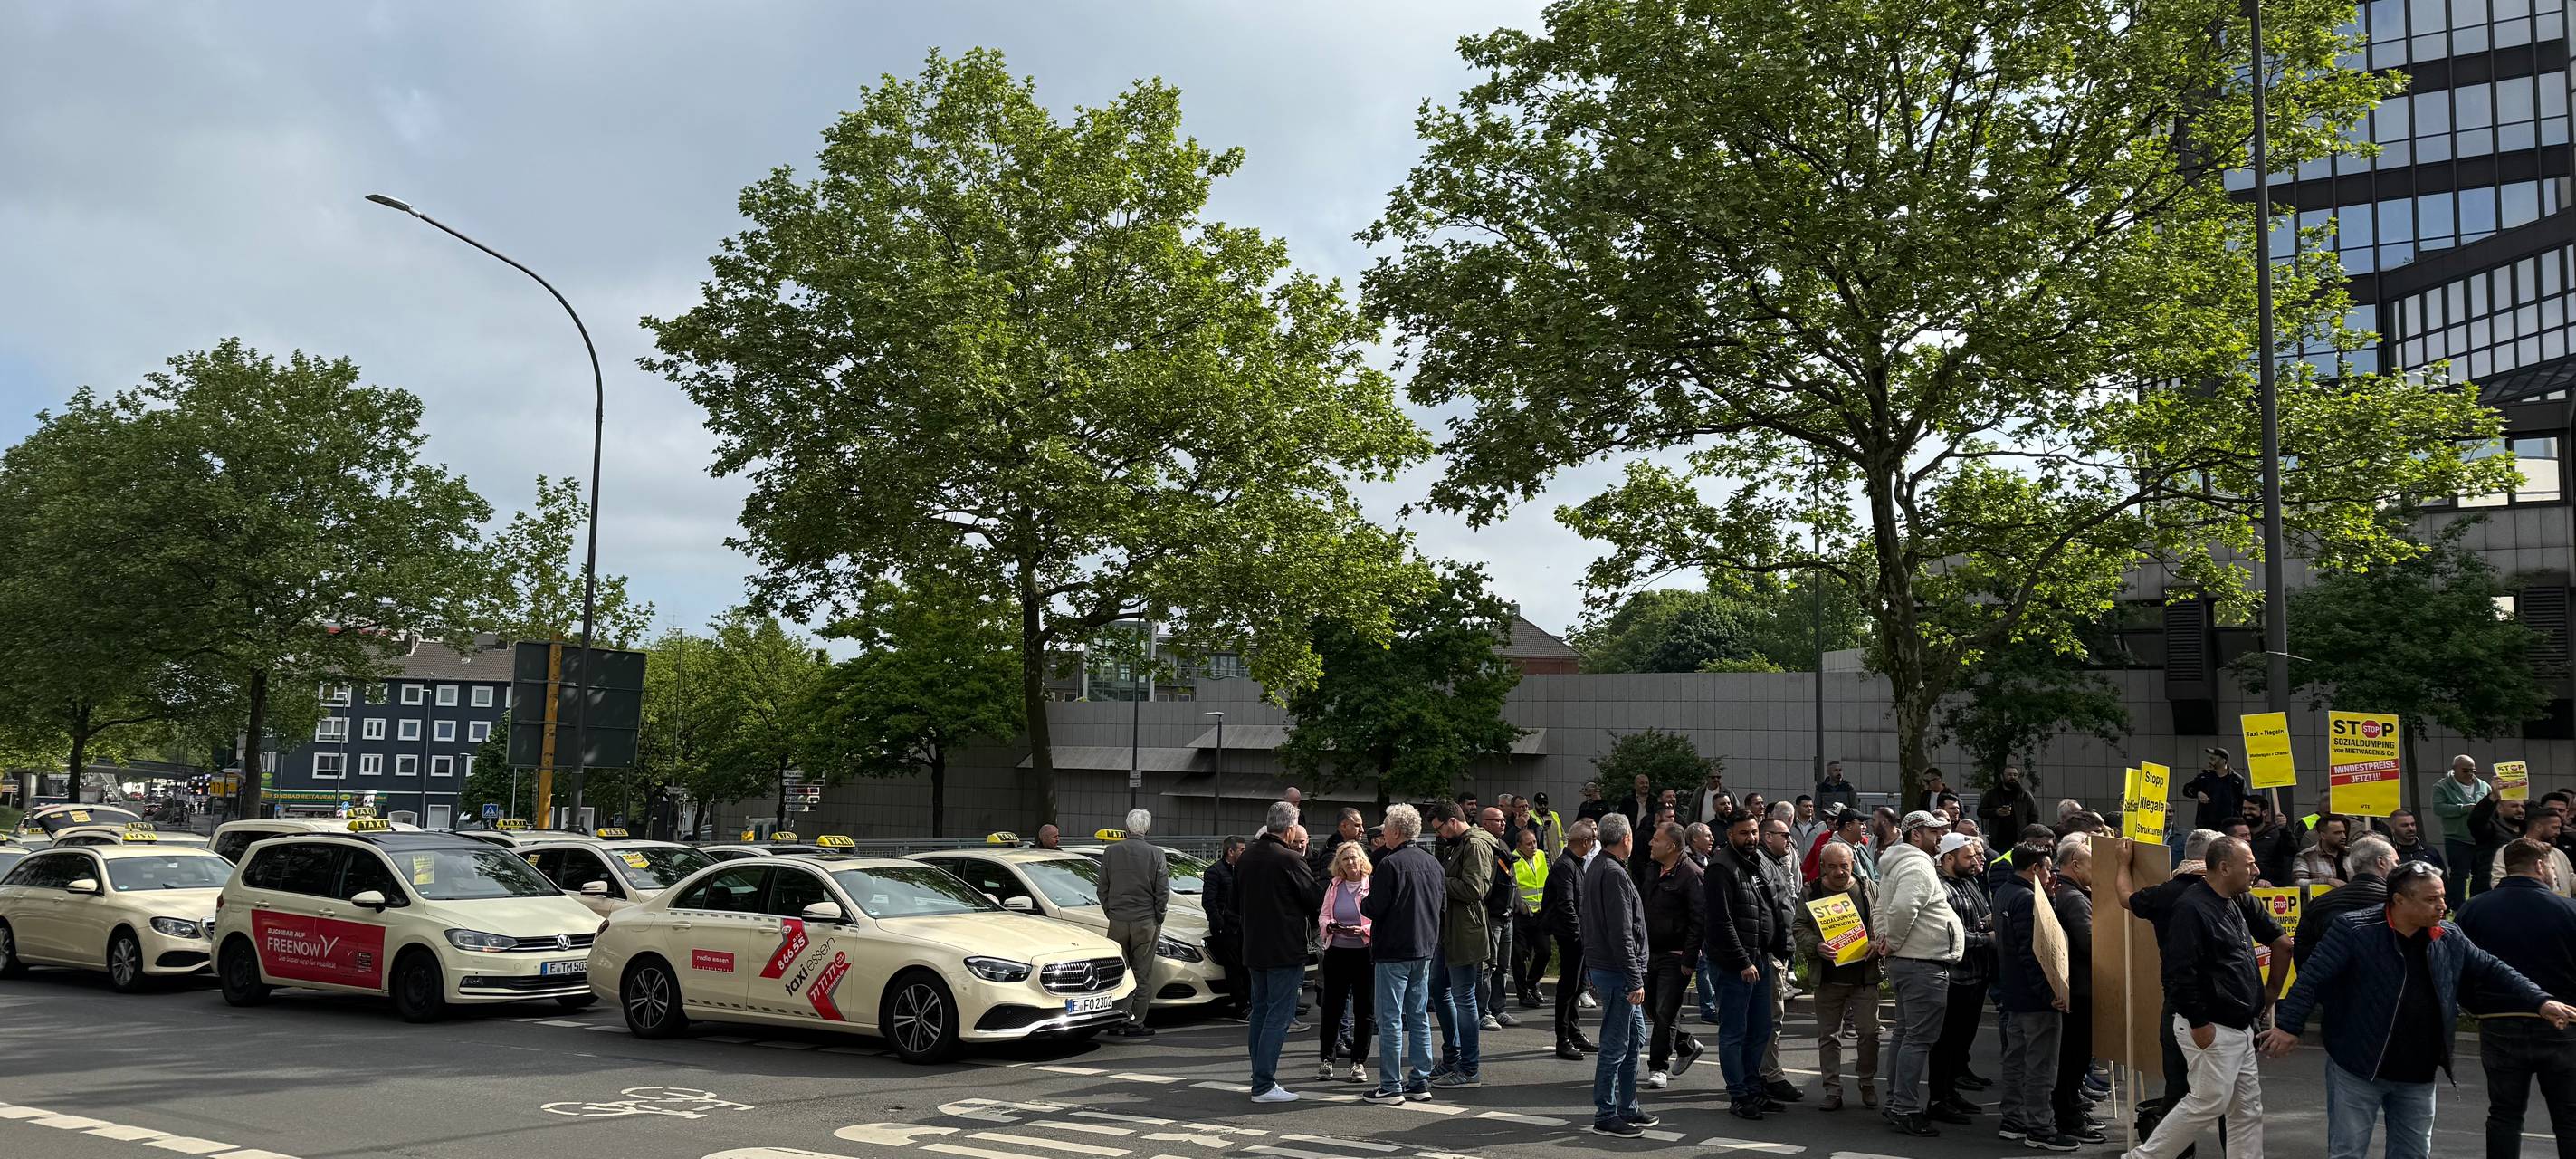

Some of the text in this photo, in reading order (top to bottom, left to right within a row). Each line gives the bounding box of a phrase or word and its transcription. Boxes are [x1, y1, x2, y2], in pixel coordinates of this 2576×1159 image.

[2333, 738, 2395, 749] SOZIALDUMPING
[2345, 748, 2380, 756] MIETWAGEN
[2334, 761, 2396, 774] MINDESTPREISE
[2145, 771, 2164, 787] Stopp
[362, 820, 387, 829] TAXI
[2137, 823, 2163, 837] Strukturen
[830, 837, 852, 845] TAXI
[2274, 901, 2286, 909] STOP
[267, 927, 294, 937] BUCHBAR
[267, 937, 320, 957] FREENOW
[550, 963, 556, 973] E
[562, 963, 572, 972] TM
[1073, 1001, 1079, 1012] E
[1095, 996, 1111, 1009] 2302
